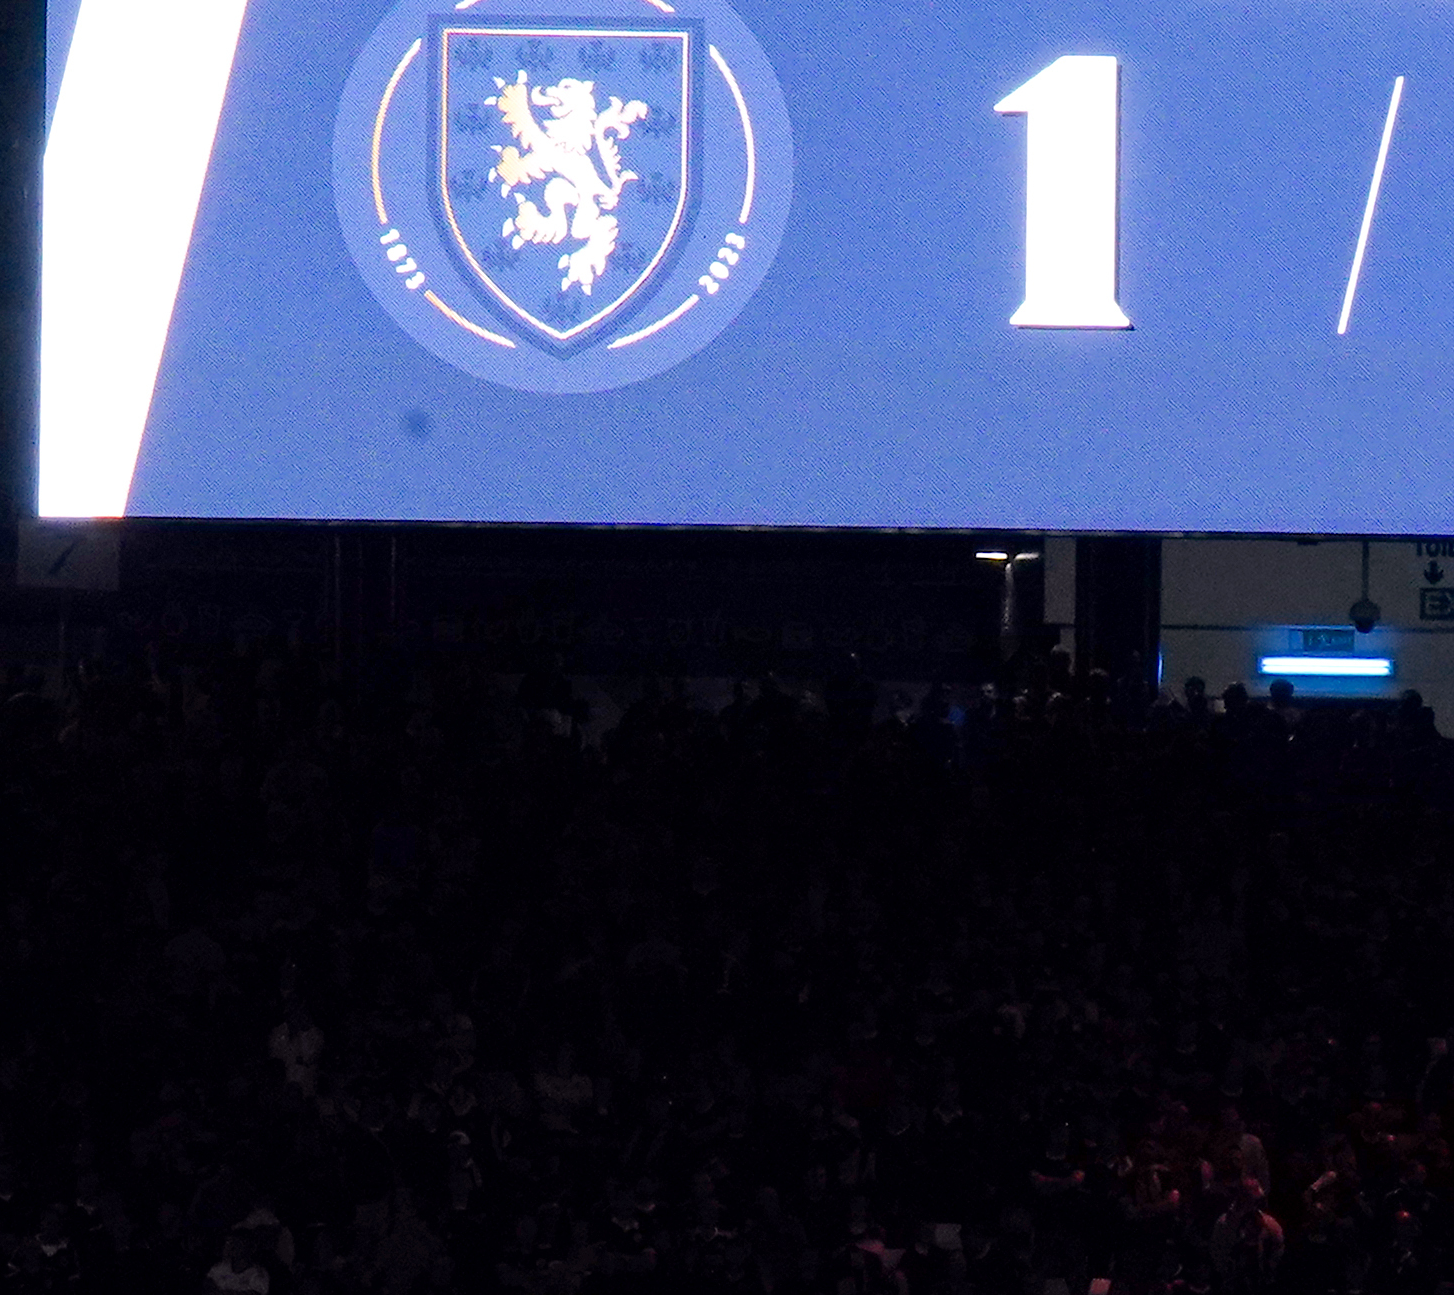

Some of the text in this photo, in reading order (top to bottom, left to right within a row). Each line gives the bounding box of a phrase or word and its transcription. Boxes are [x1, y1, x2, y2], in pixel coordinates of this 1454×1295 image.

[992, 54, 1134, 331] 1
[379, 228, 426, 290] 1873
[698, 232, 746, 295] 2023
